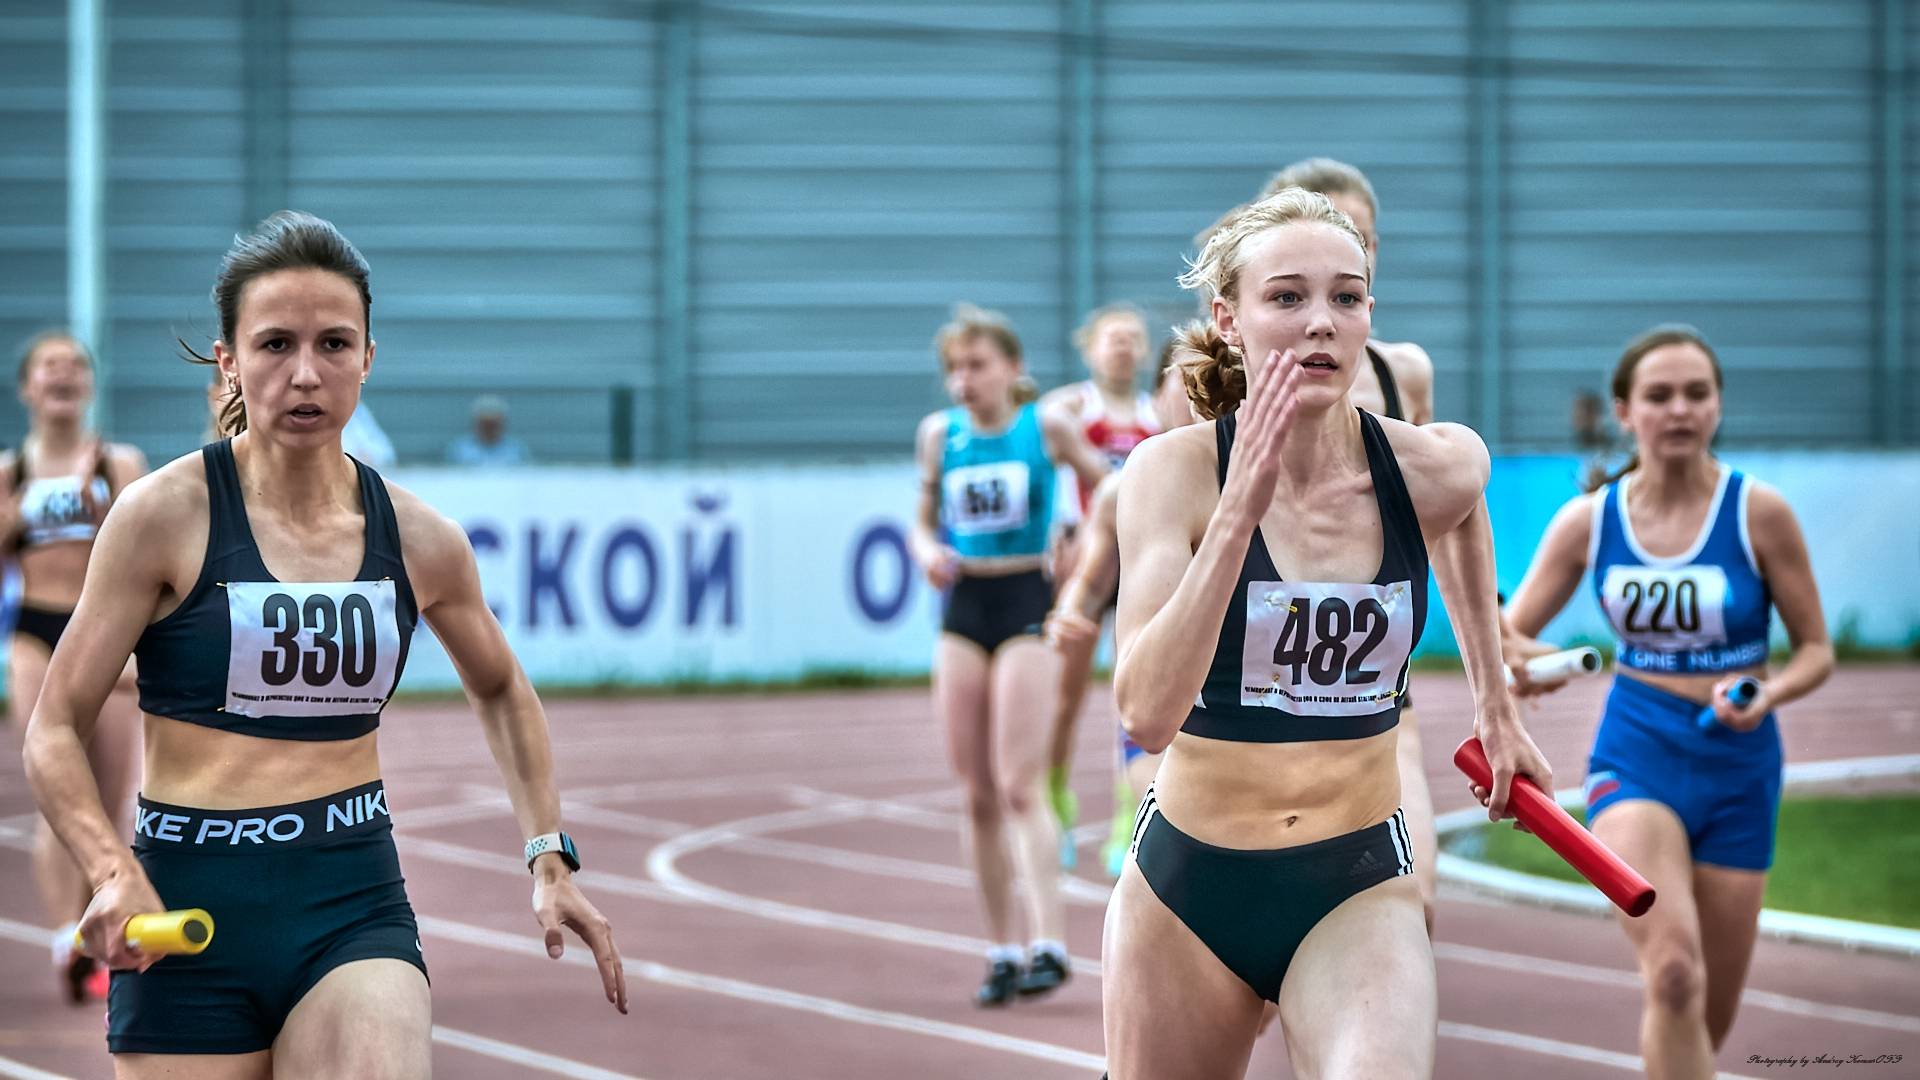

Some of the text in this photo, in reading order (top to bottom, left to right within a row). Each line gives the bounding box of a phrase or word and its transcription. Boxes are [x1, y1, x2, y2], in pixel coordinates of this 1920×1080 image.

[261, 593, 377, 687] 330
[1273, 597, 1389, 686] 482
[1622, 579, 1701, 633] 220
[194, 813, 305, 845] PRO
